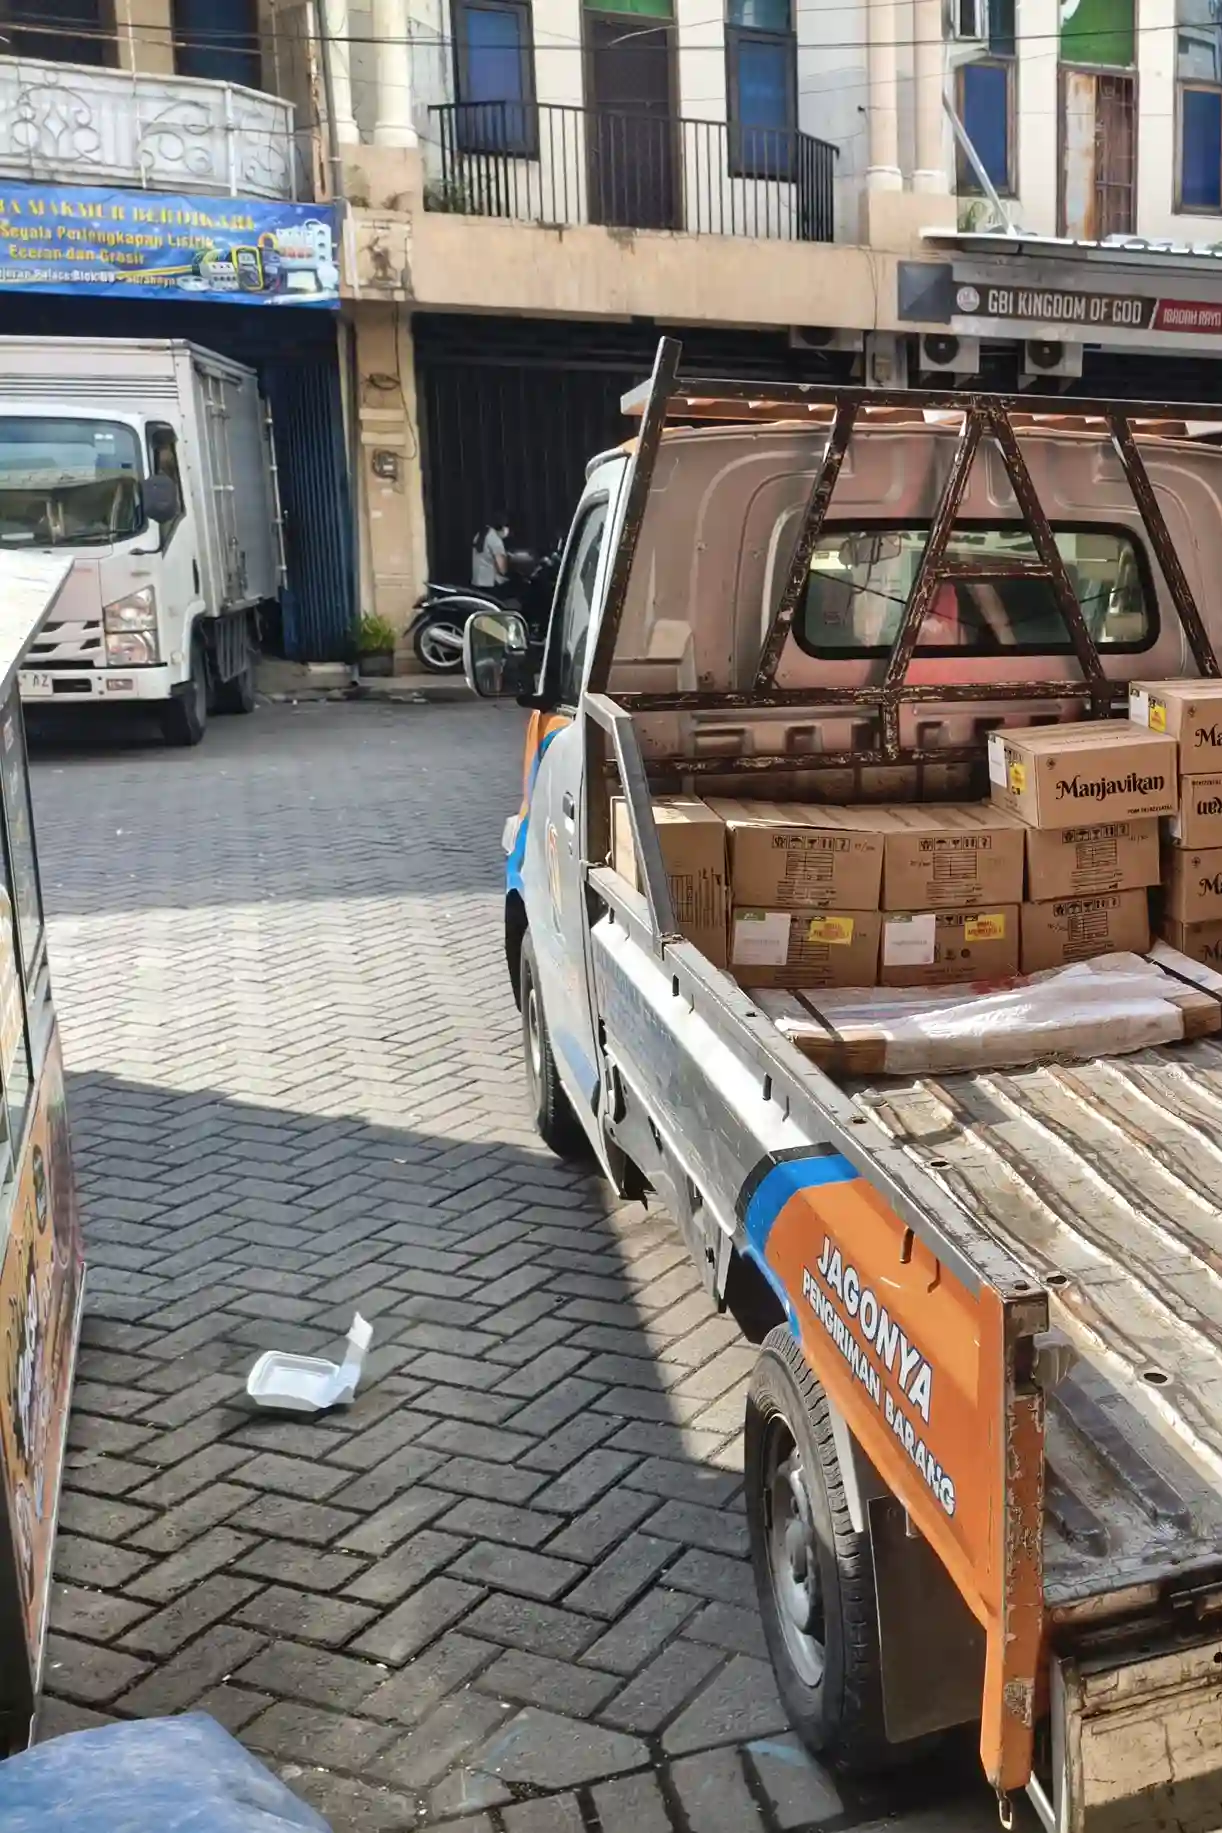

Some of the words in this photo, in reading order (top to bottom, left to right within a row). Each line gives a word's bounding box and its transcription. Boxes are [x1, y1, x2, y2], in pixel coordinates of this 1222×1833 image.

[66, 246, 96, 261] dan
[987, 289, 1014, 315] GBI
[1017, 292, 1086, 320] KINGDOM
[1090, 299, 1110, 322] OF
[1112, 300, 1143, 324] GOD
[1055, 772, 1165, 801] Manjavikan
[816, 1234, 934, 1427] JAGONYA
[802, 1267, 882, 1410] PENGIRIMAN
[883, 1387, 957, 1518] BARANG
